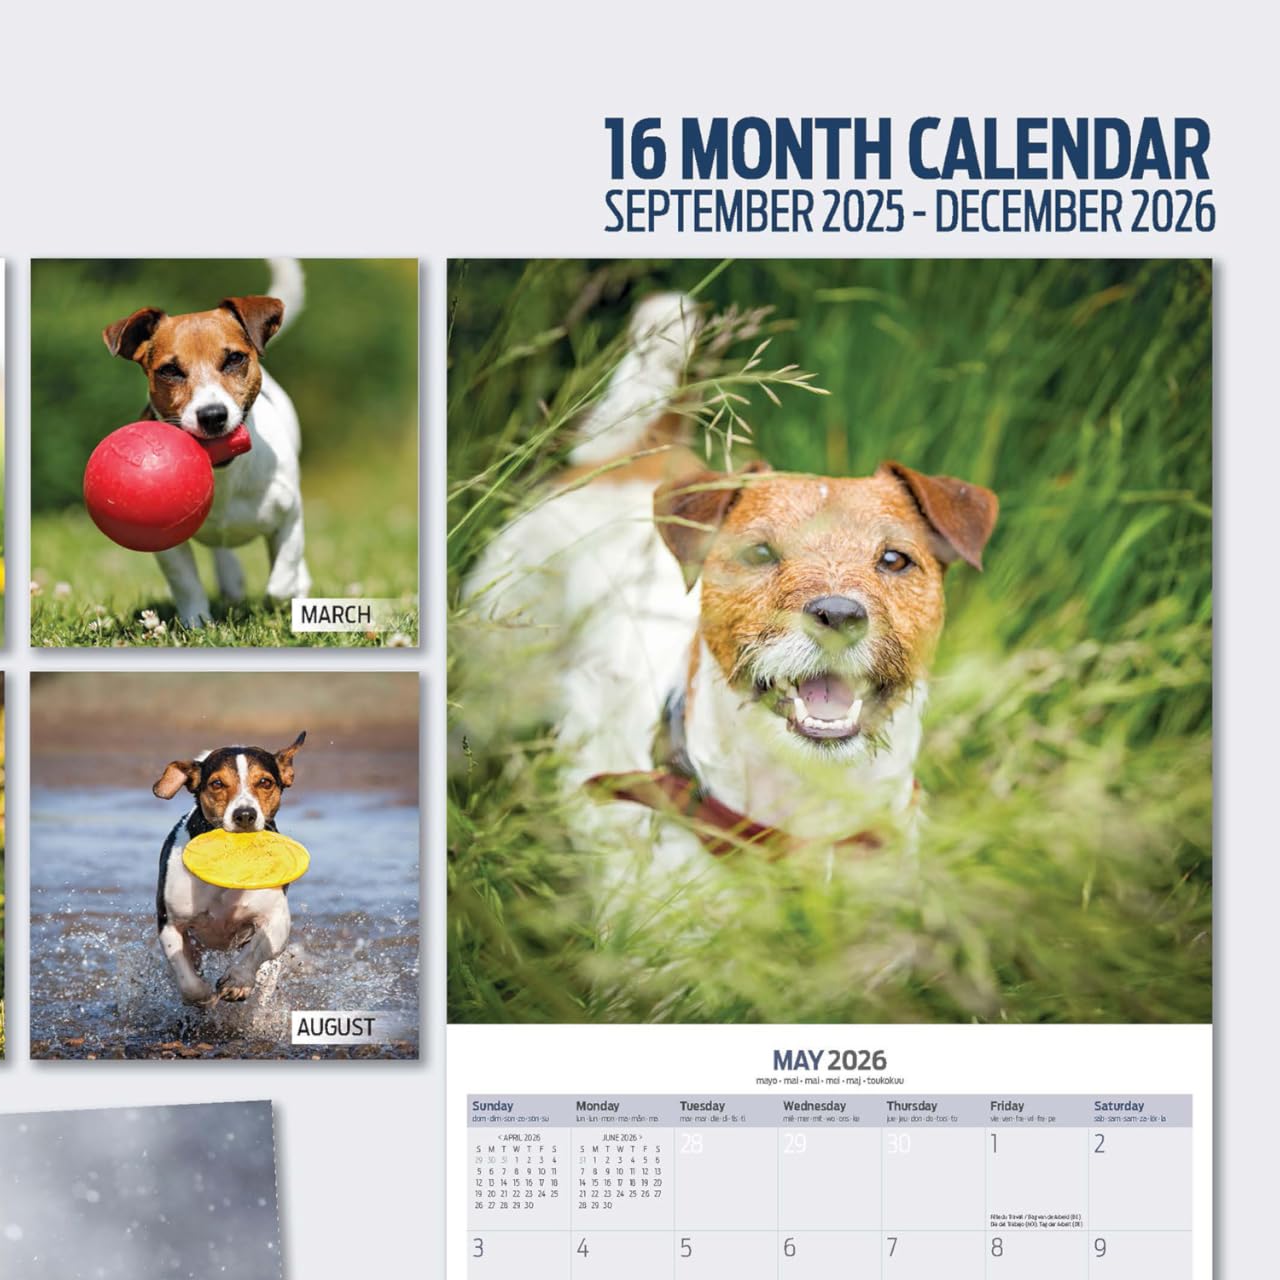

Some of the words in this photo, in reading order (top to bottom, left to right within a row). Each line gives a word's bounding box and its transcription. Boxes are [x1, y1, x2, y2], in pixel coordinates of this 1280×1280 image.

[605, 118, 666, 179] 16
[682, 117, 891, 180] MONTH
[909, 116, 1210, 180] CALENDAR
[604, 189, 814, 232] SEPTEMBER
[822, 189, 904, 232] 2025
[936, 189, 1122, 232] DECEMBER
[1131, 189, 1215, 232] 2026
[302, 606, 370, 623] MARCH
[298, 1018, 375, 1036] AUGUST
[774, 1050, 824, 1070] MAY
[828, 1050, 887, 1070] 2026
[756, 1078, 777, 1086] mayo
[867, 1076, 904, 1084] toukokuu
[473, 1101, 513, 1112] Sunday
[577, 1101, 619, 1112] Monday
[680, 1101, 725, 1112] Tuesday
[784, 1101, 846, 1112] Wednesday
[886, 1101, 937, 1112] Thursday
[991, 1101, 1024, 1112] Friday
[1095, 1101, 1144, 1112] Saturday
[680, 1133, 703, 1153] 28
[784, 1133, 806, 1153] 29
[888, 1133, 910, 1153] 30
[991, 1134, 996, 1153] 1
[1095, 1134, 1104, 1153] 2
